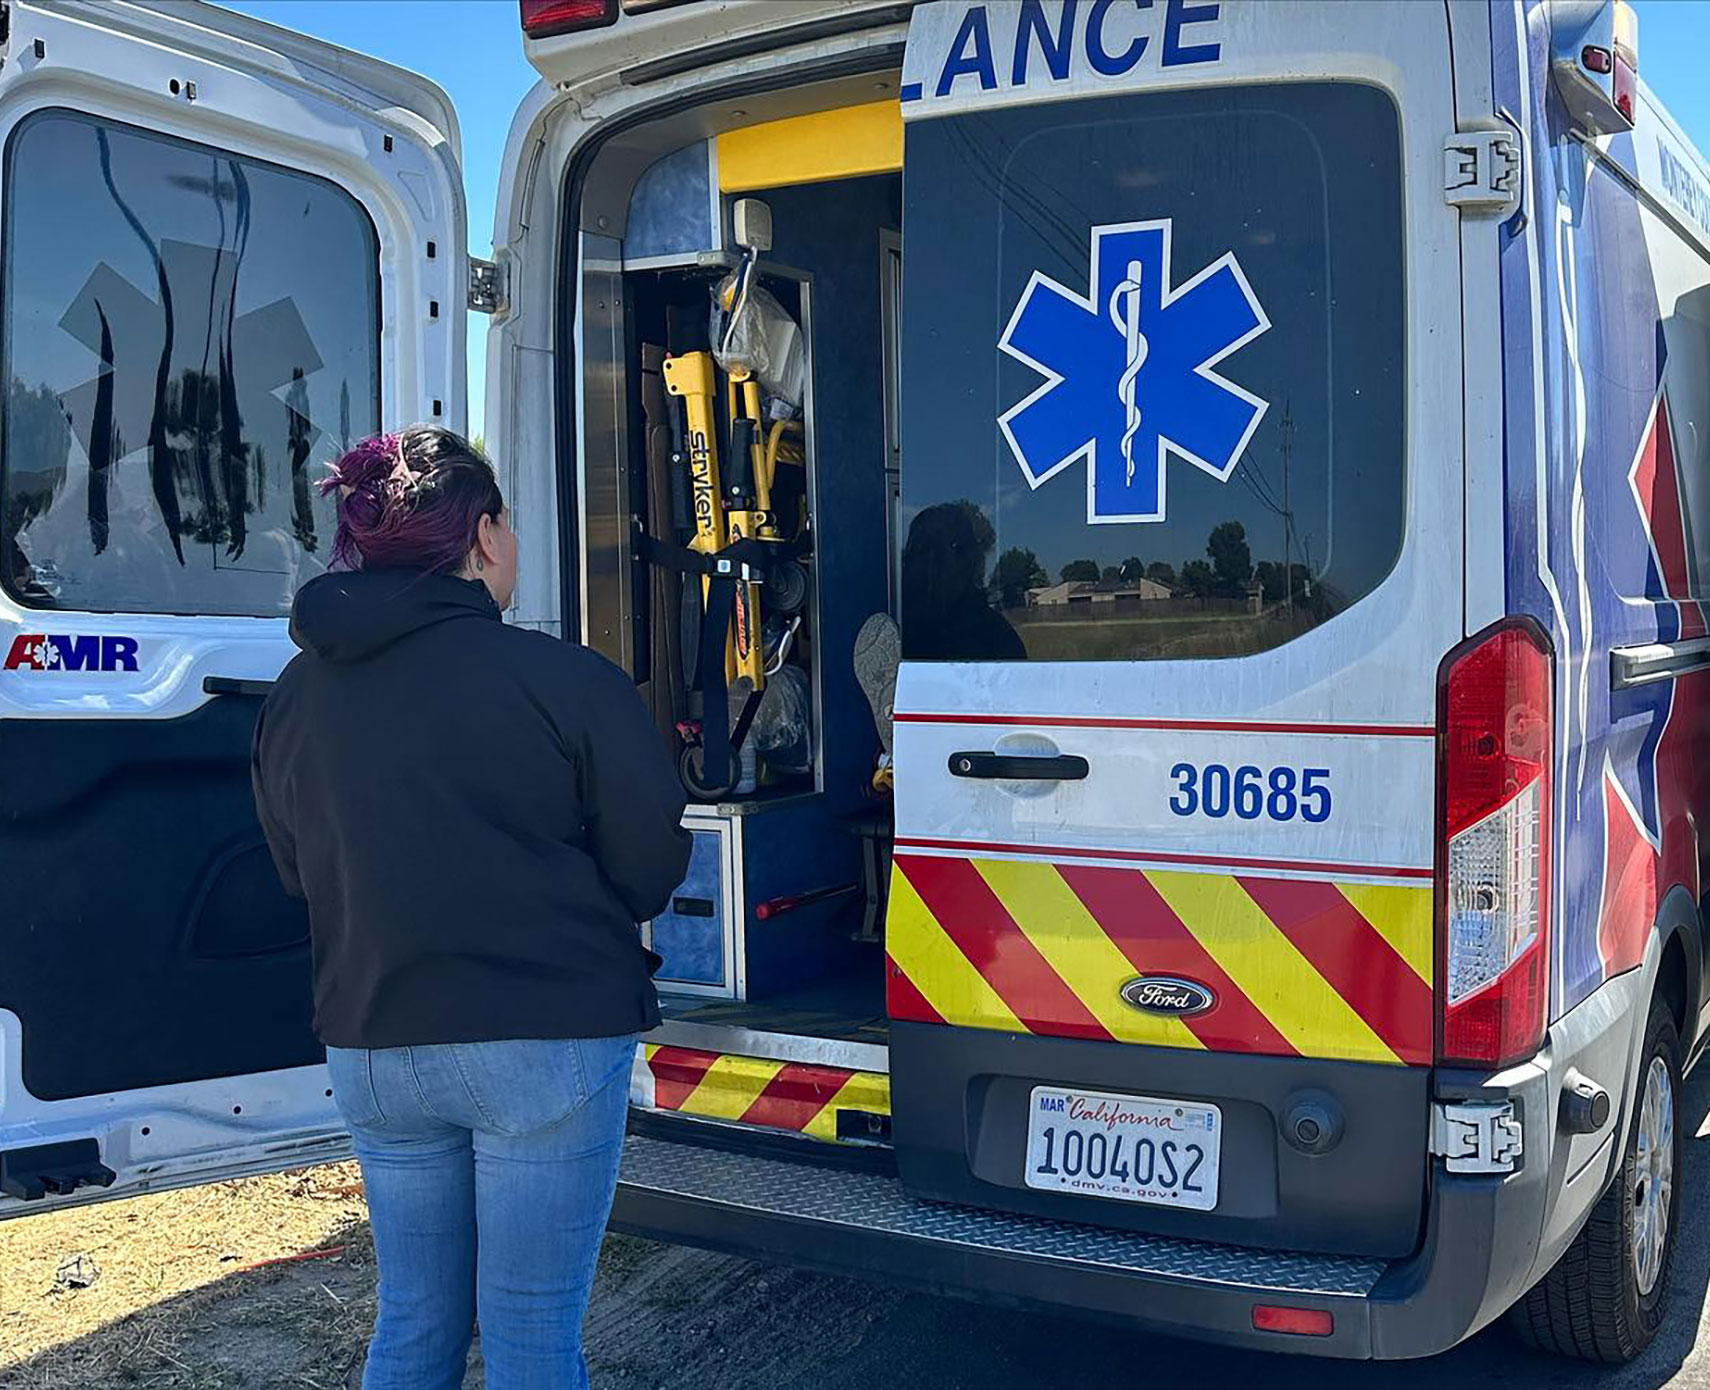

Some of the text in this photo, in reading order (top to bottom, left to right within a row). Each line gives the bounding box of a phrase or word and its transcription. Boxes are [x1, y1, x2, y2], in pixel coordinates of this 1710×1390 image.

[901, 0, 1222, 102] ANCE
[690, 430, 714, 528] stryker
[3, 634, 140, 671] AMR
[1169, 763, 1332, 822] 30685
[1138, 984, 1190, 1008] Ford
[1039, 1097, 1065, 1113] MAR
[1069, 1098, 1184, 1131] California
[1036, 1127, 1205, 1193] 10040S2
[1071, 1179, 1168, 1198] dmv.ca.gov
